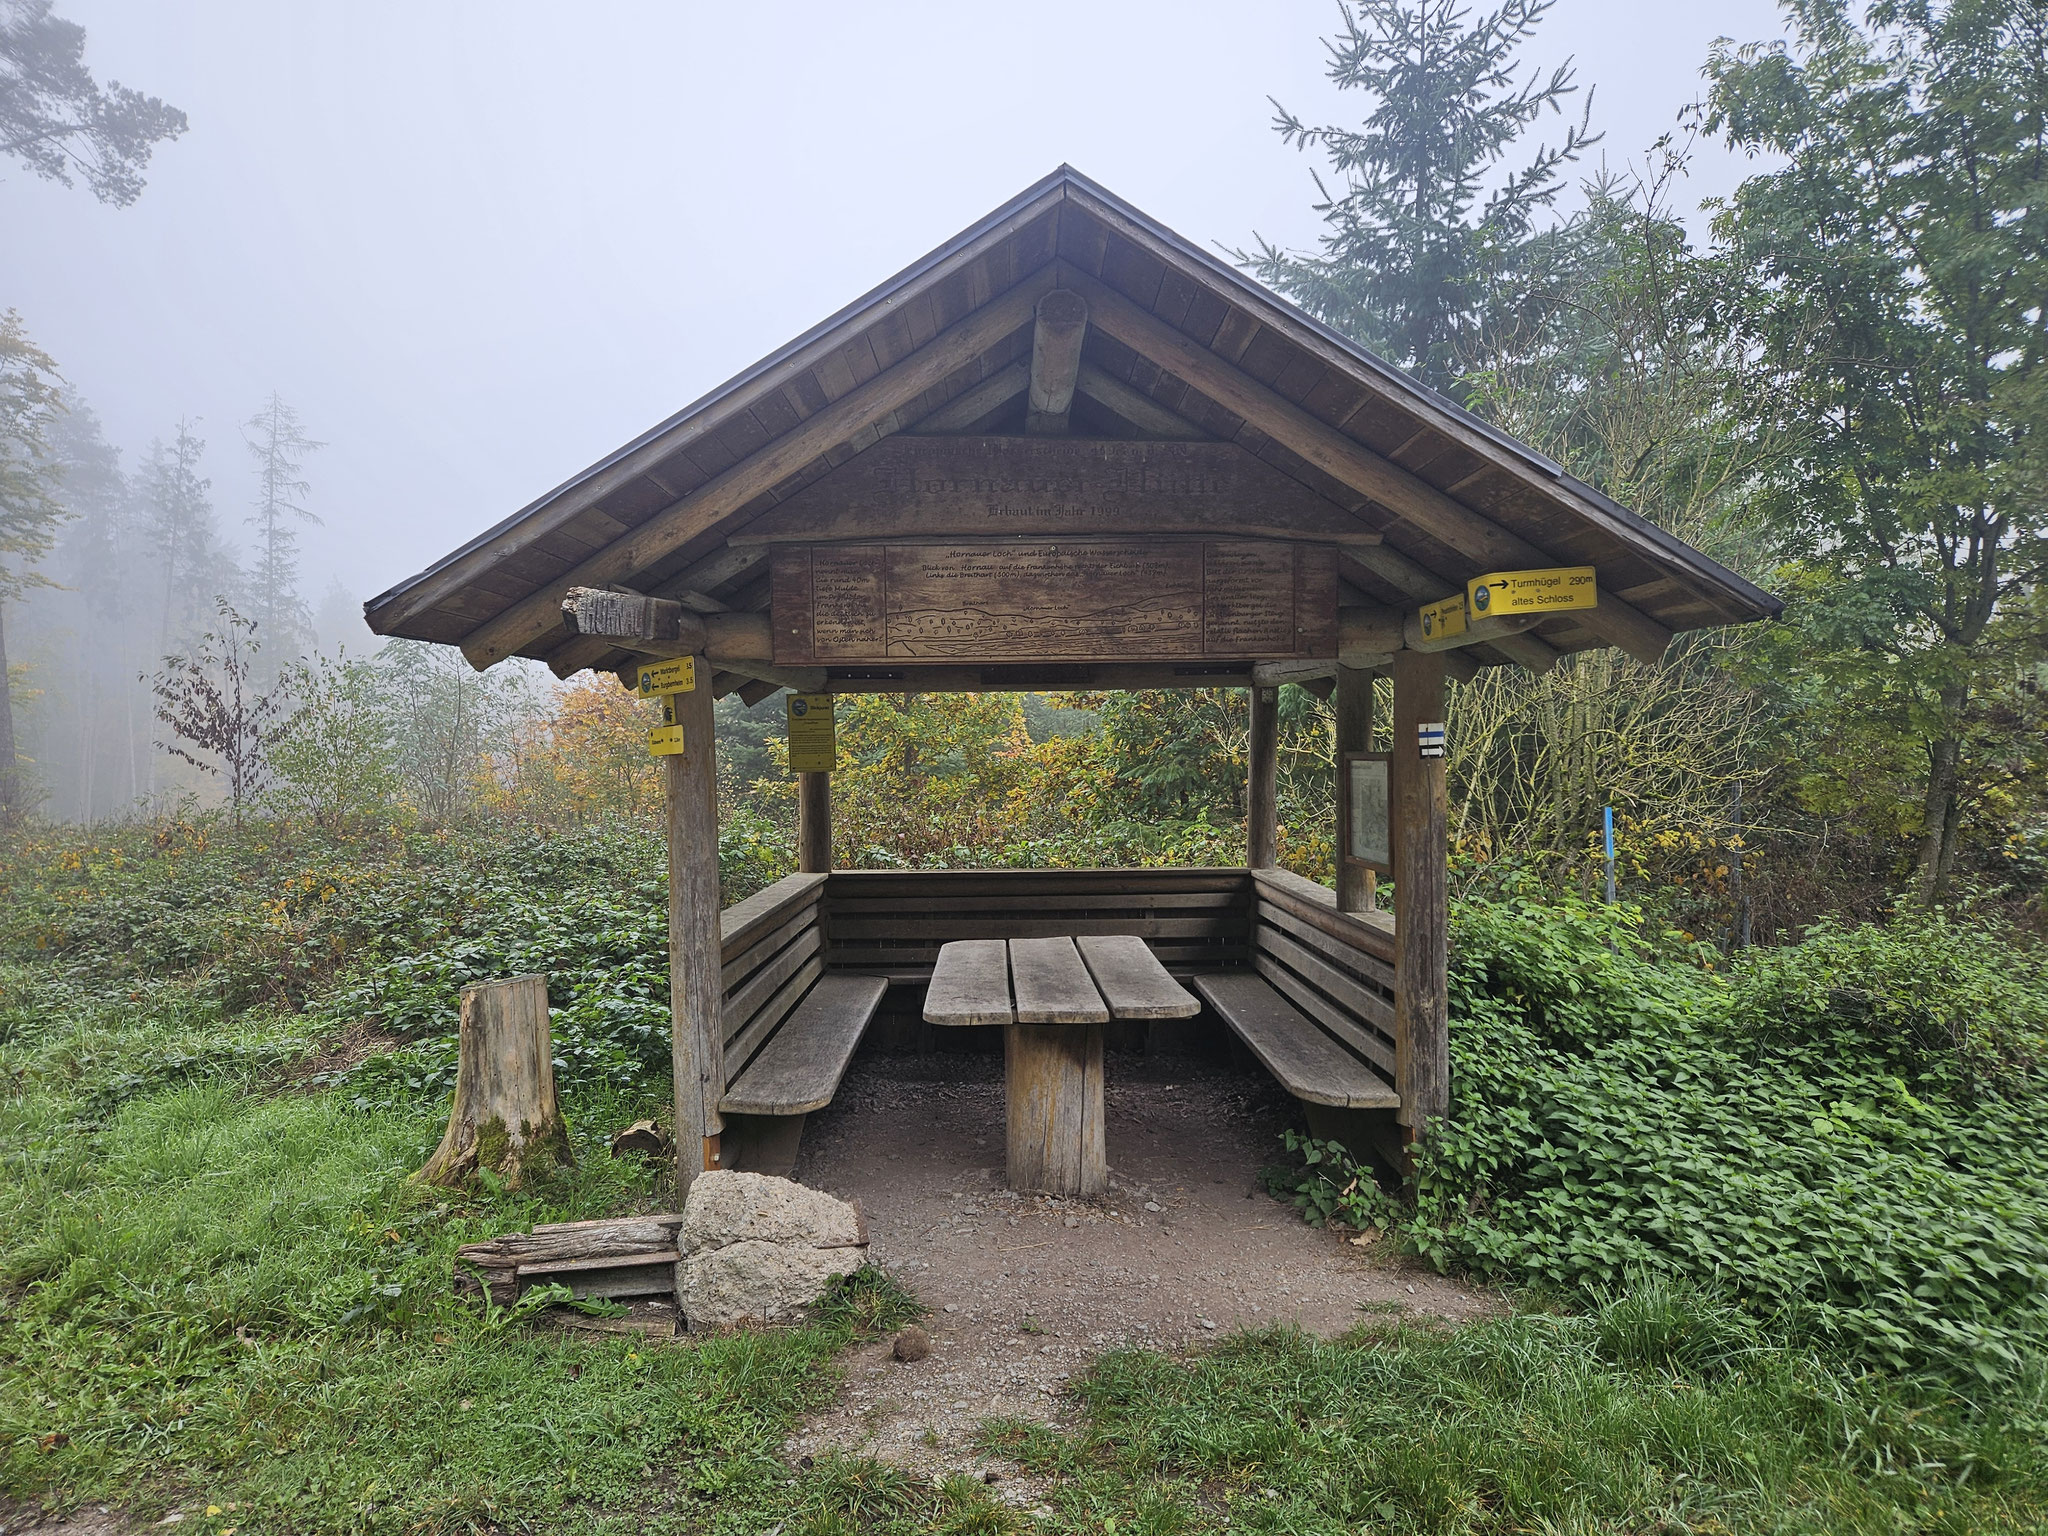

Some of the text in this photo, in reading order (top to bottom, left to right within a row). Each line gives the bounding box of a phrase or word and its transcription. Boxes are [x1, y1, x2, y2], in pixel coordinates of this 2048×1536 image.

[986, 503, 1121, 518] Erbaut im Jahr 1999
[1018, 549, 1038, 558] und
[921, 564, 939, 572] Blick
[960, 563, 995, 571] Hornau
[998, 563, 1012, 572] auf
[1012, 563, 1025, 571] die
[925, 571, 945, 580] Links
[946, 571, 959, 579] die
[1511, 576, 1594, 590] Turmhügel 290m
[1511, 594, 1575, 607] altes Schloss
